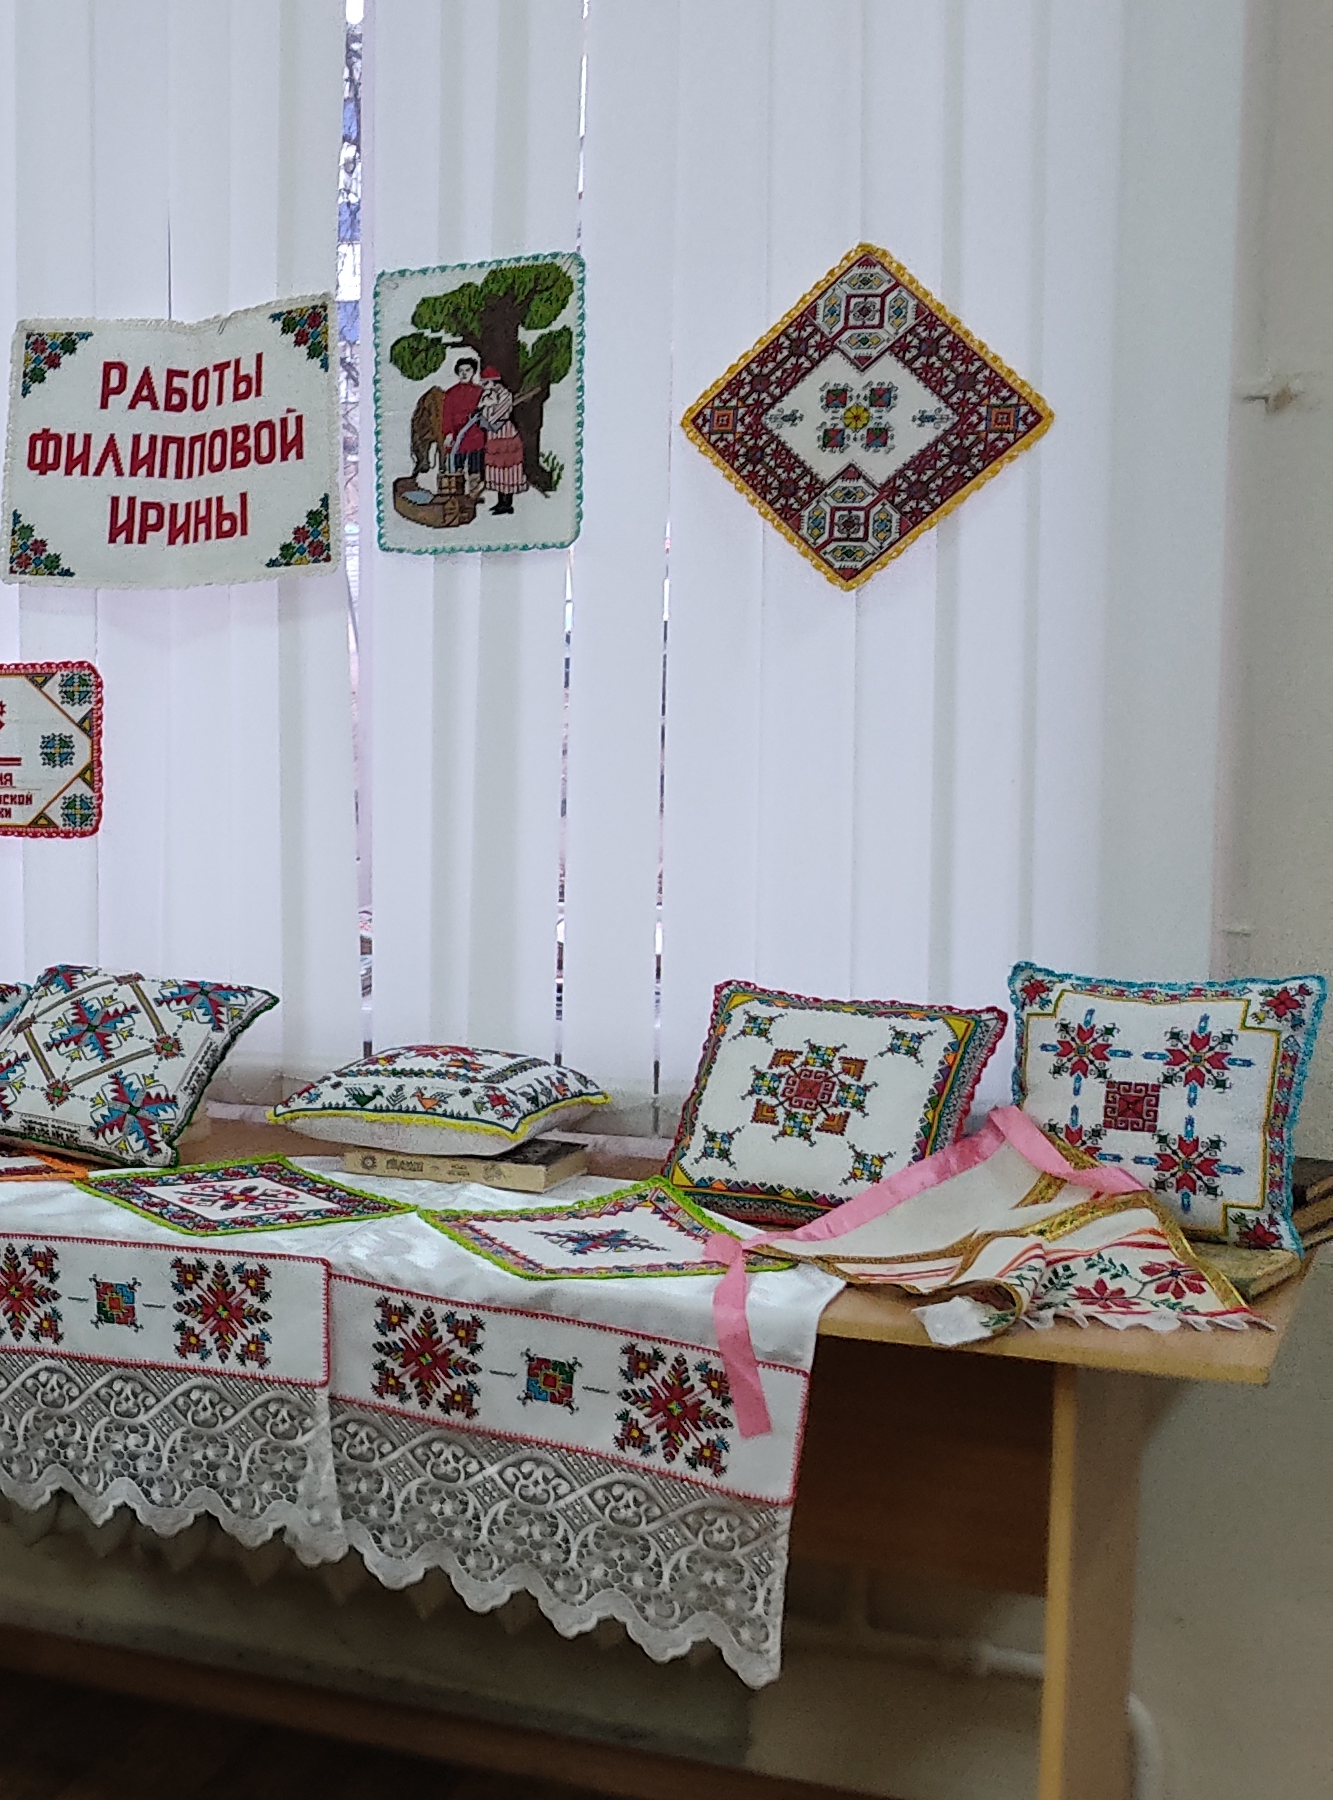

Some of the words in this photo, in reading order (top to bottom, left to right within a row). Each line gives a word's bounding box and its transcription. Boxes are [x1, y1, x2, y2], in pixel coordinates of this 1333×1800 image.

[99, 352, 264, 413] РАБОТЫ
[26, 407, 304, 480] ФИЛИППОВОЙ
[107, 491, 248, 546] ИРИНЫ
